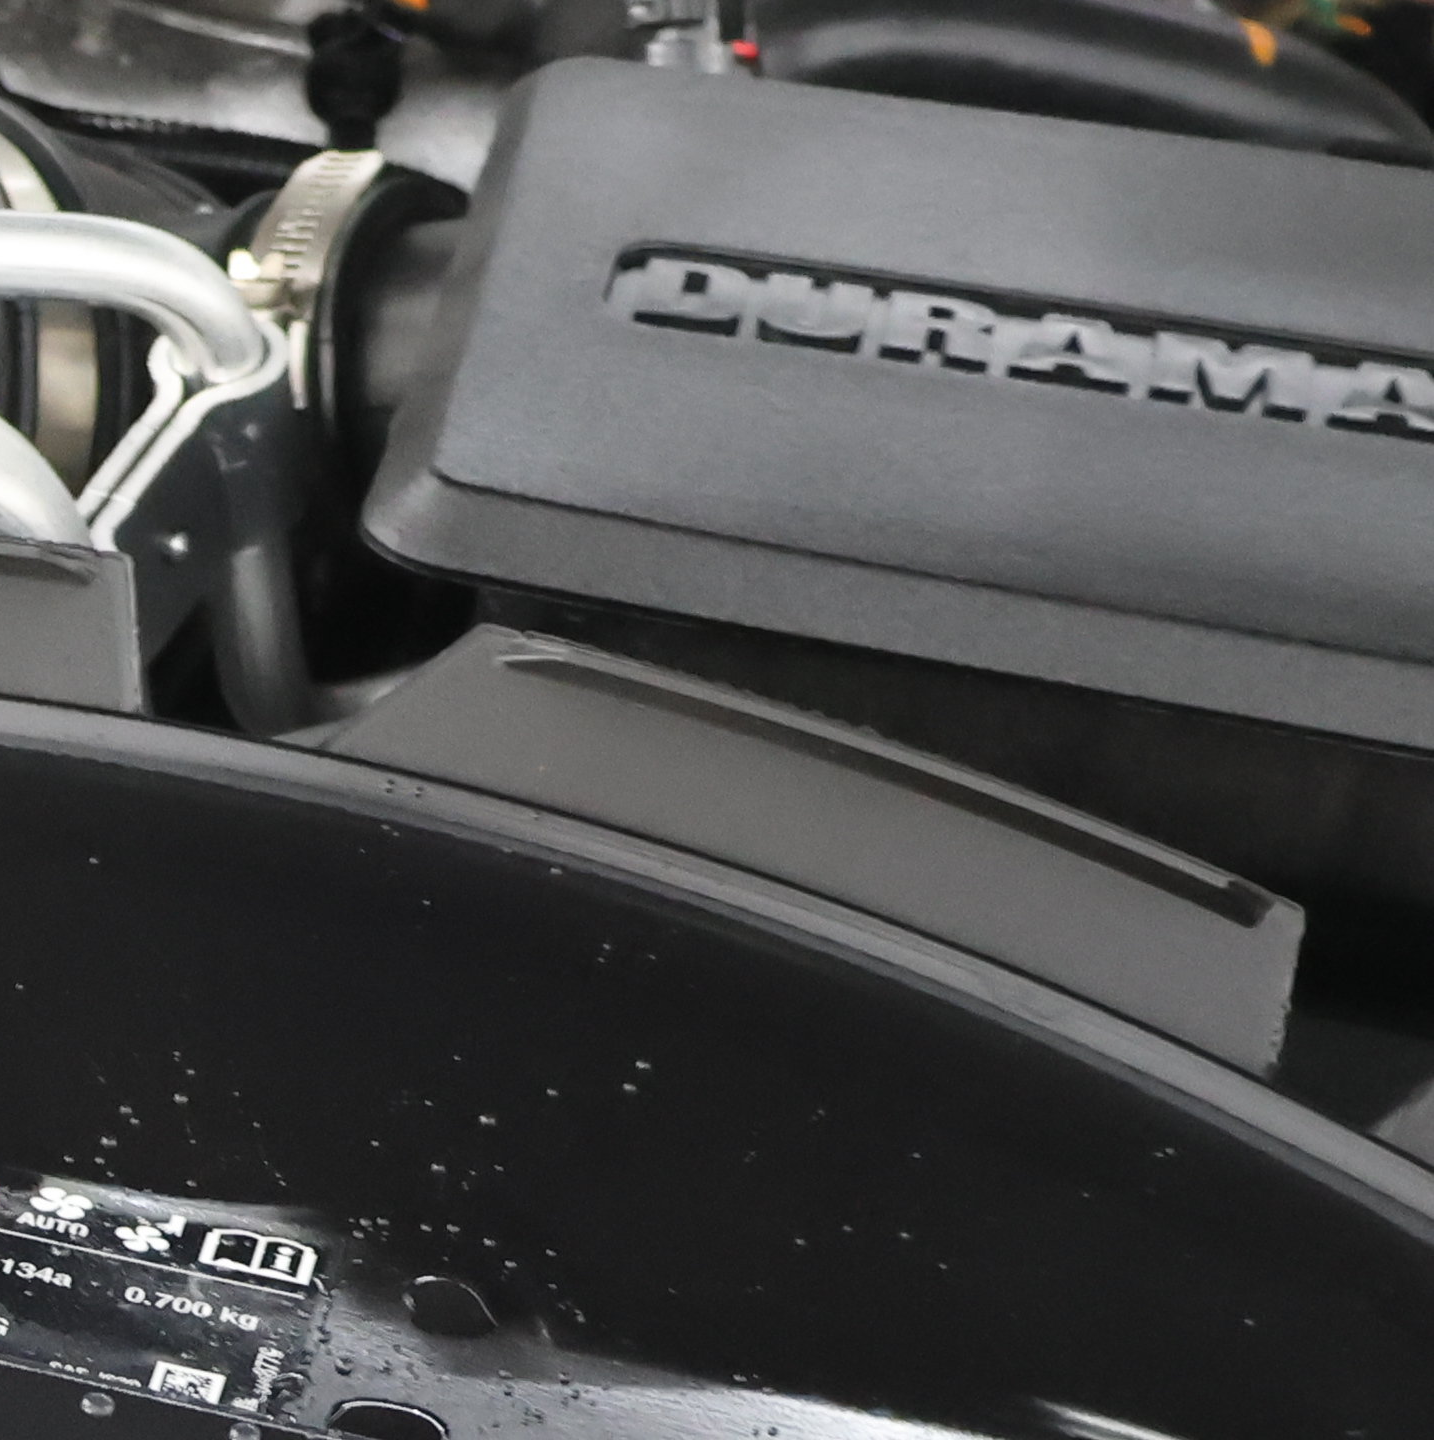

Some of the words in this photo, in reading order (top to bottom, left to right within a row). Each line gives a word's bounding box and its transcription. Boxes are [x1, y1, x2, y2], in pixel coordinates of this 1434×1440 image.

[16, 1211, 90, 1238] AUTO
[124, 1285, 213, 1319] 0.700
[218, 1305, 260, 1332] kg
